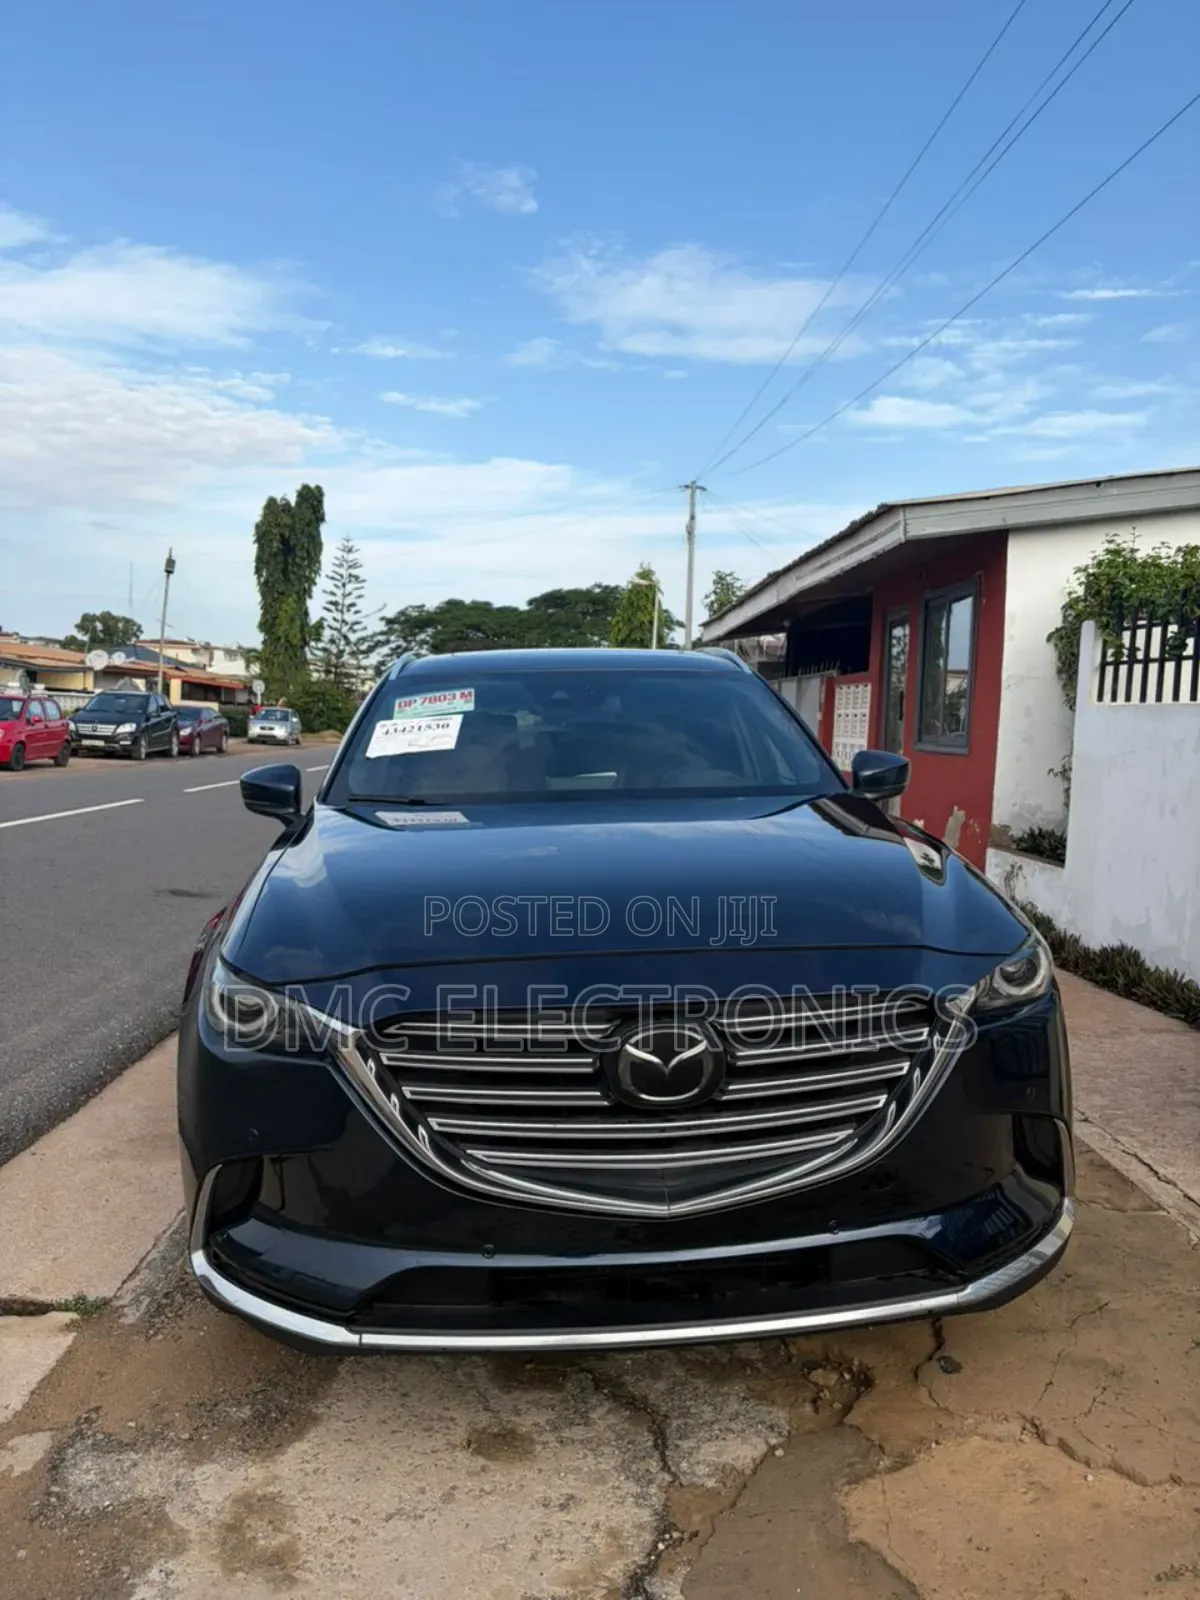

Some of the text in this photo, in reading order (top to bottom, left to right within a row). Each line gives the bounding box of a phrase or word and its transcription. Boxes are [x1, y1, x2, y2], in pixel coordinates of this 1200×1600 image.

[397, 690, 473, 710] DP 7803 M
